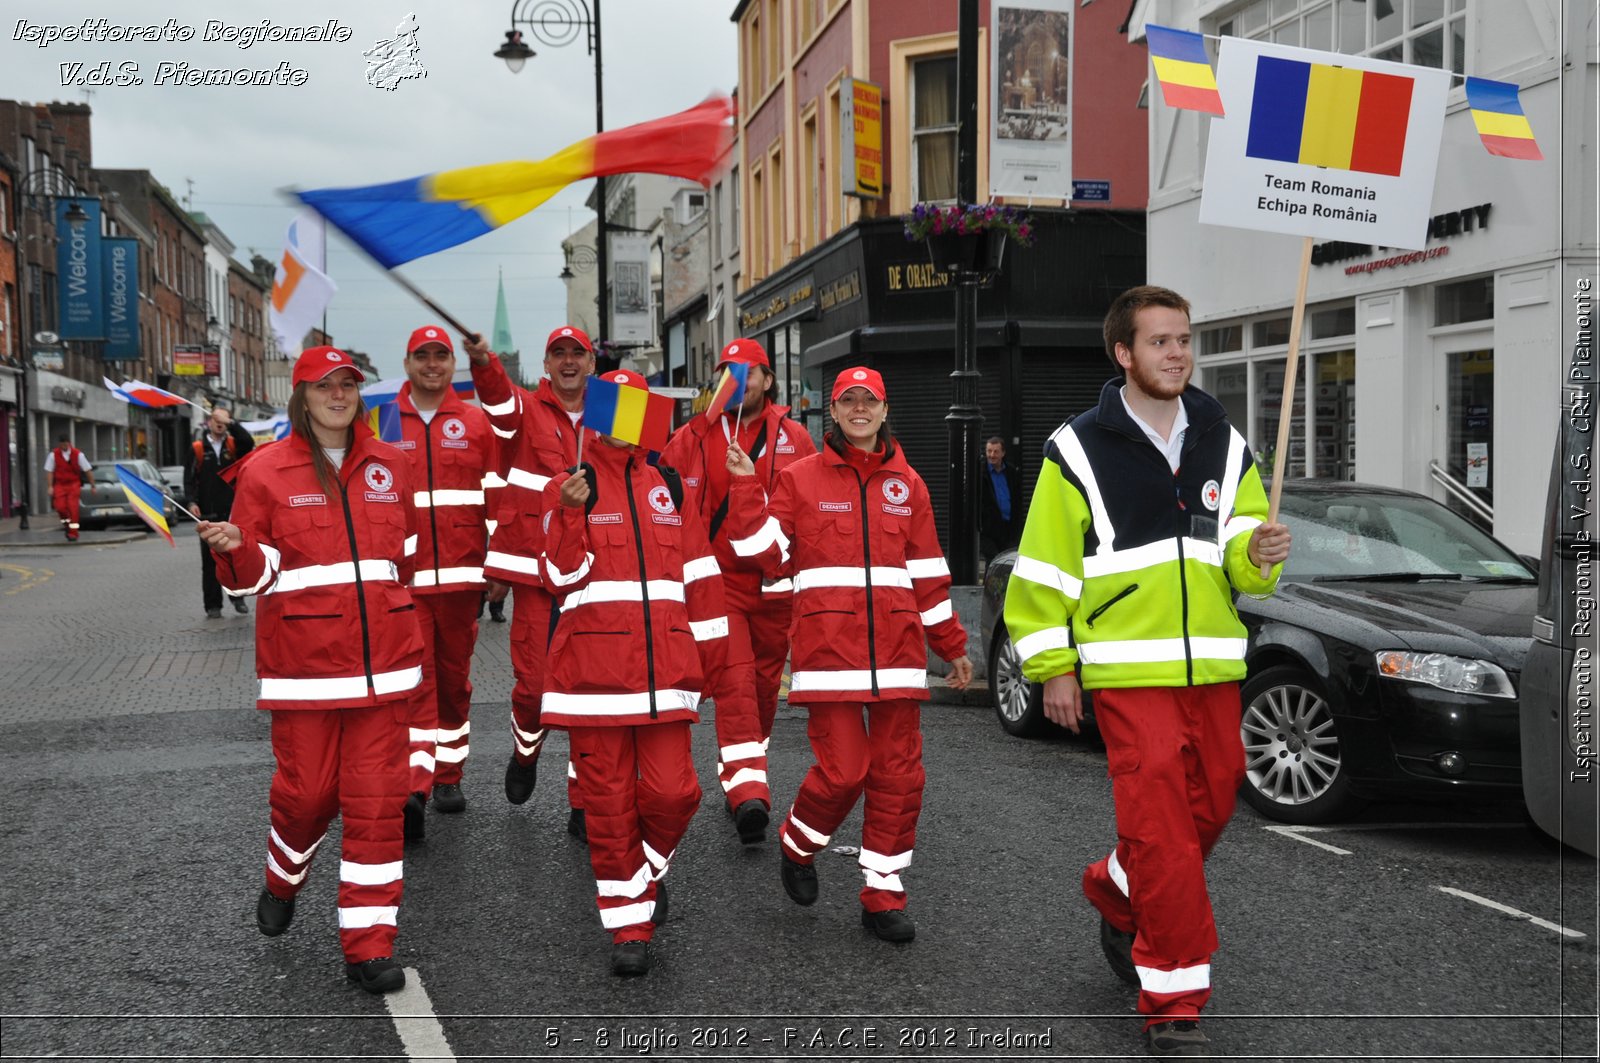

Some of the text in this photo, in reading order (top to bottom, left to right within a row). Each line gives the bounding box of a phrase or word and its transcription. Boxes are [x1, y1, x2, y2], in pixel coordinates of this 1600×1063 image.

[1264, 174, 1377, 201] Team Romania
[1257, 196, 1378, 223] Echipa România
[110, 246, 127, 323] Welcome
[888, 266, 903, 290] DE
[293, 496, 323, 504] DEZASTRE
[367, 493, 395, 501] VOLUNTAR
[884, 506, 909, 514] VOLUNTAR
